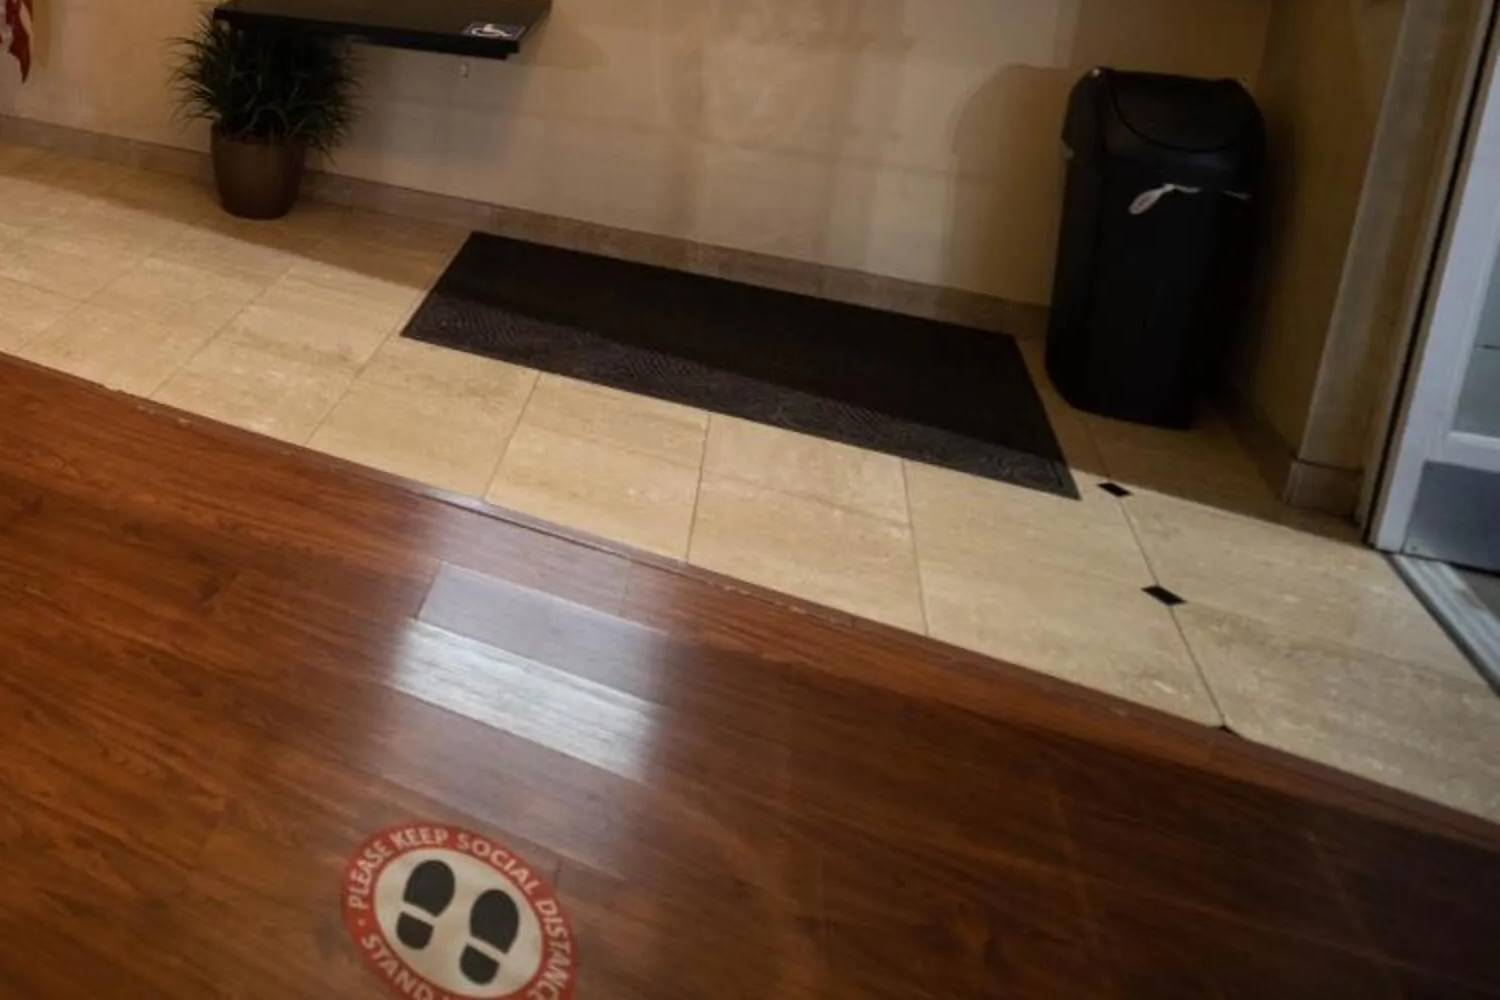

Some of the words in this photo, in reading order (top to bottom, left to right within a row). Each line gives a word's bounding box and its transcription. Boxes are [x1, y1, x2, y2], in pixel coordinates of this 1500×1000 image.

[348, 840, 393, 910] PLEASE
[389, 827, 449, 850] KEEP
[457, 832, 541, 896] SOCIAL
[361, 933, 435, 1000] STAND
